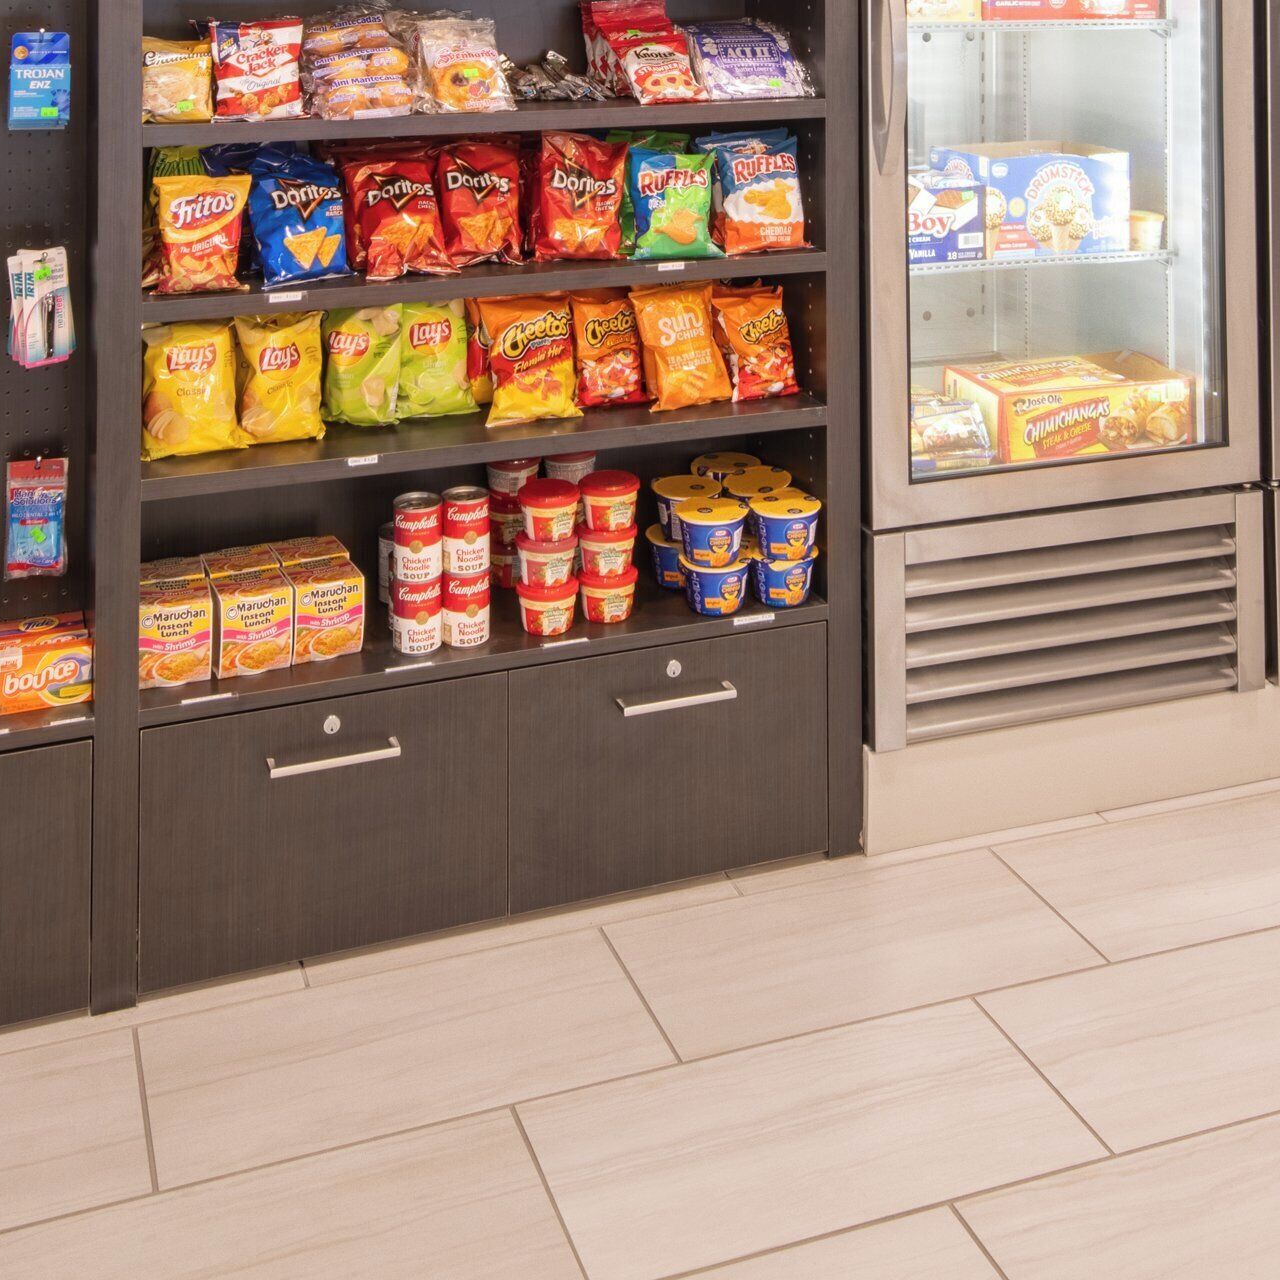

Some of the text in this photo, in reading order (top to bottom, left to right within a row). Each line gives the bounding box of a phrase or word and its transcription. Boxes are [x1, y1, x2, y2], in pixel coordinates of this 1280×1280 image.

[235, 44, 288, 64] Cracker
[315, 45, 393, 67] Mini Mantecadas
[727, 46, 770, 59] ACT II
[15, 69, 65, 79] TROJAN
[244, 61, 277, 77] Jack
[29, 80, 51, 89] ENZ
[246, 77, 281, 91] Original
[733, 153, 796, 185] RUFFLES
[447, 171, 510, 194] Doritos
[552, 169, 617, 196] Doritos
[638, 168, 709, 198] RUFFLES
[1026, 167, 1093, 201] DRUMSTICK
[271, 183, 342, 211] Doritos
[367, 181, 435, 207] Doritos
[170, 191, 236, 229] Fritos
[759, 226, 793, 236] CHEDDAR
[909, 211, 953, 237] Boy
[947, 251, 958, 261] 18
[24, 271, 35, 299] TRIM
[411, 320, 450, 347] Lay's
[502, 313, 568, 359] Cheetos
[658, 311, 701, 347] Sun
[677, 327, 705, 342] CHIPS
[169, 345, 217, 372] Lay's
[261, 343, 299, 370] Lay's
[548, 344, 565, 359] Hot
[1026, 395, 1047, 410] José
[1023, 398, 1111, 446] CHIMICHANGAS
[1042, 424, 1094, 449] STEAK CHEESE
[13, 496, 57, 507] Solutions
[456, 547, 485, 556] Chicken
[457, 554, 484, 563] Noodle
[401, 556, 432, 566] Chicken
[402, 562, 431, 571] Noodle
[457, 562, 484, 572] SOUP
[403, 571, 431, 580] SOUP
[310, 583, 359, 599] Maruchan
[236, 595, 287, 612] Maruchan
[314, 596, 347, 608] Instant
[317, 603, 344, 615] Lunch
[152, 609, 206, 623] Maruchan
[240, 609, 275, 623] Instant
[244, 617, 272, 629] Lunch
[321, 612, 351, 627] Shrimp
[23, 619, 54, 631] Tide
[156, 620, 193, 632] Instant
[407, 626, 437, 636] Chicken
[457, 619, 486, 630] Chicken
[160, 628, 190, 639] Lunch
[247, 626, 278, 641] Shrimp
[408, 634, 435, 643] Noodle
[458, 628, 485, 637] Noodle
[164, 637, 197, 651] Shrimp
[408, 642, 435, 653] SOUP
[458, 635, 486, 646] SOUP
[4, 660, 77, 695] bounce
